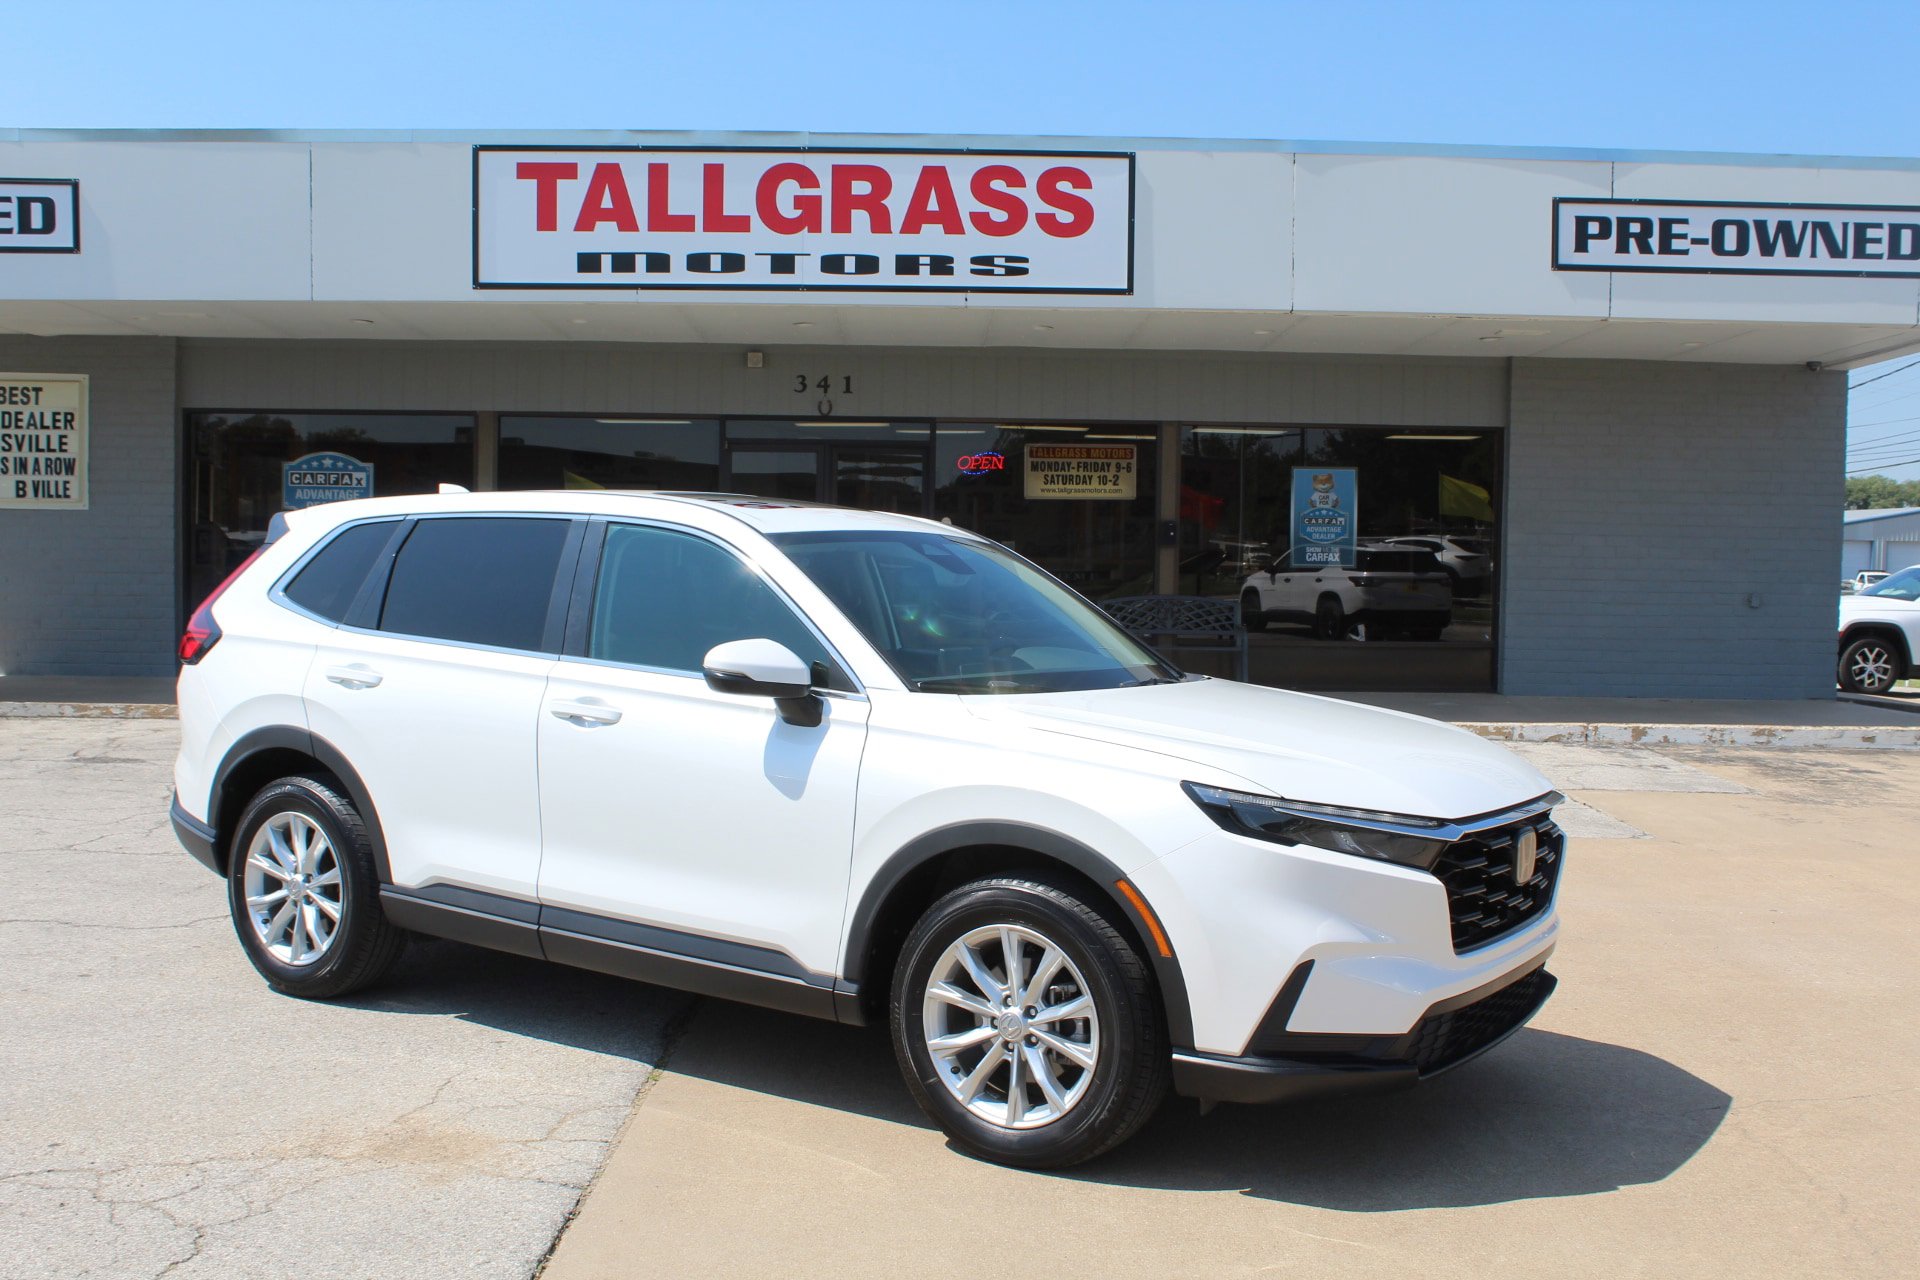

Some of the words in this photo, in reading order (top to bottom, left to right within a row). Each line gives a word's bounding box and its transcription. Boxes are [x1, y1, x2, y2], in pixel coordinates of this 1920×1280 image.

[516, 161, 1095, 238] TALLGRASS
[1573, 215, 1920, 261] PRE-OWNED
[577, 252, 1030, 277] MOTORS
[793, 374, 853, 394] 341
[0, 386, 43, 406] BEST
[1, 411, 75, 430] DEALER
[1, 433, 68, 453] SVILLE
[1032, 447, 1087, 458] TALLGRASS
[1090, 448, 1132, 459] MOTORS
[13, 457, 28, 475] IN
[32, 457, 42, 475] A
[45, 458, 76, 476] ROW
[957, 455, 1005, 470] OPEN
[1030, 461, 1112, 473] MONDAY-FRIDAY
[1115, 462, 1132, 473] 9-6
[290, 472, 365, 487] CARFAX
[1043, 474, 1093, 485] SATURDAY
[1097, 474, 1120, 486] 10-2
[15, 480, 28, 498] B
[32, 480, 71, 498] VILLE
[1040, 487, 1123, 495] www.tallgrassmotors.com
[1305, 553, 1341, 562] CARFAX
